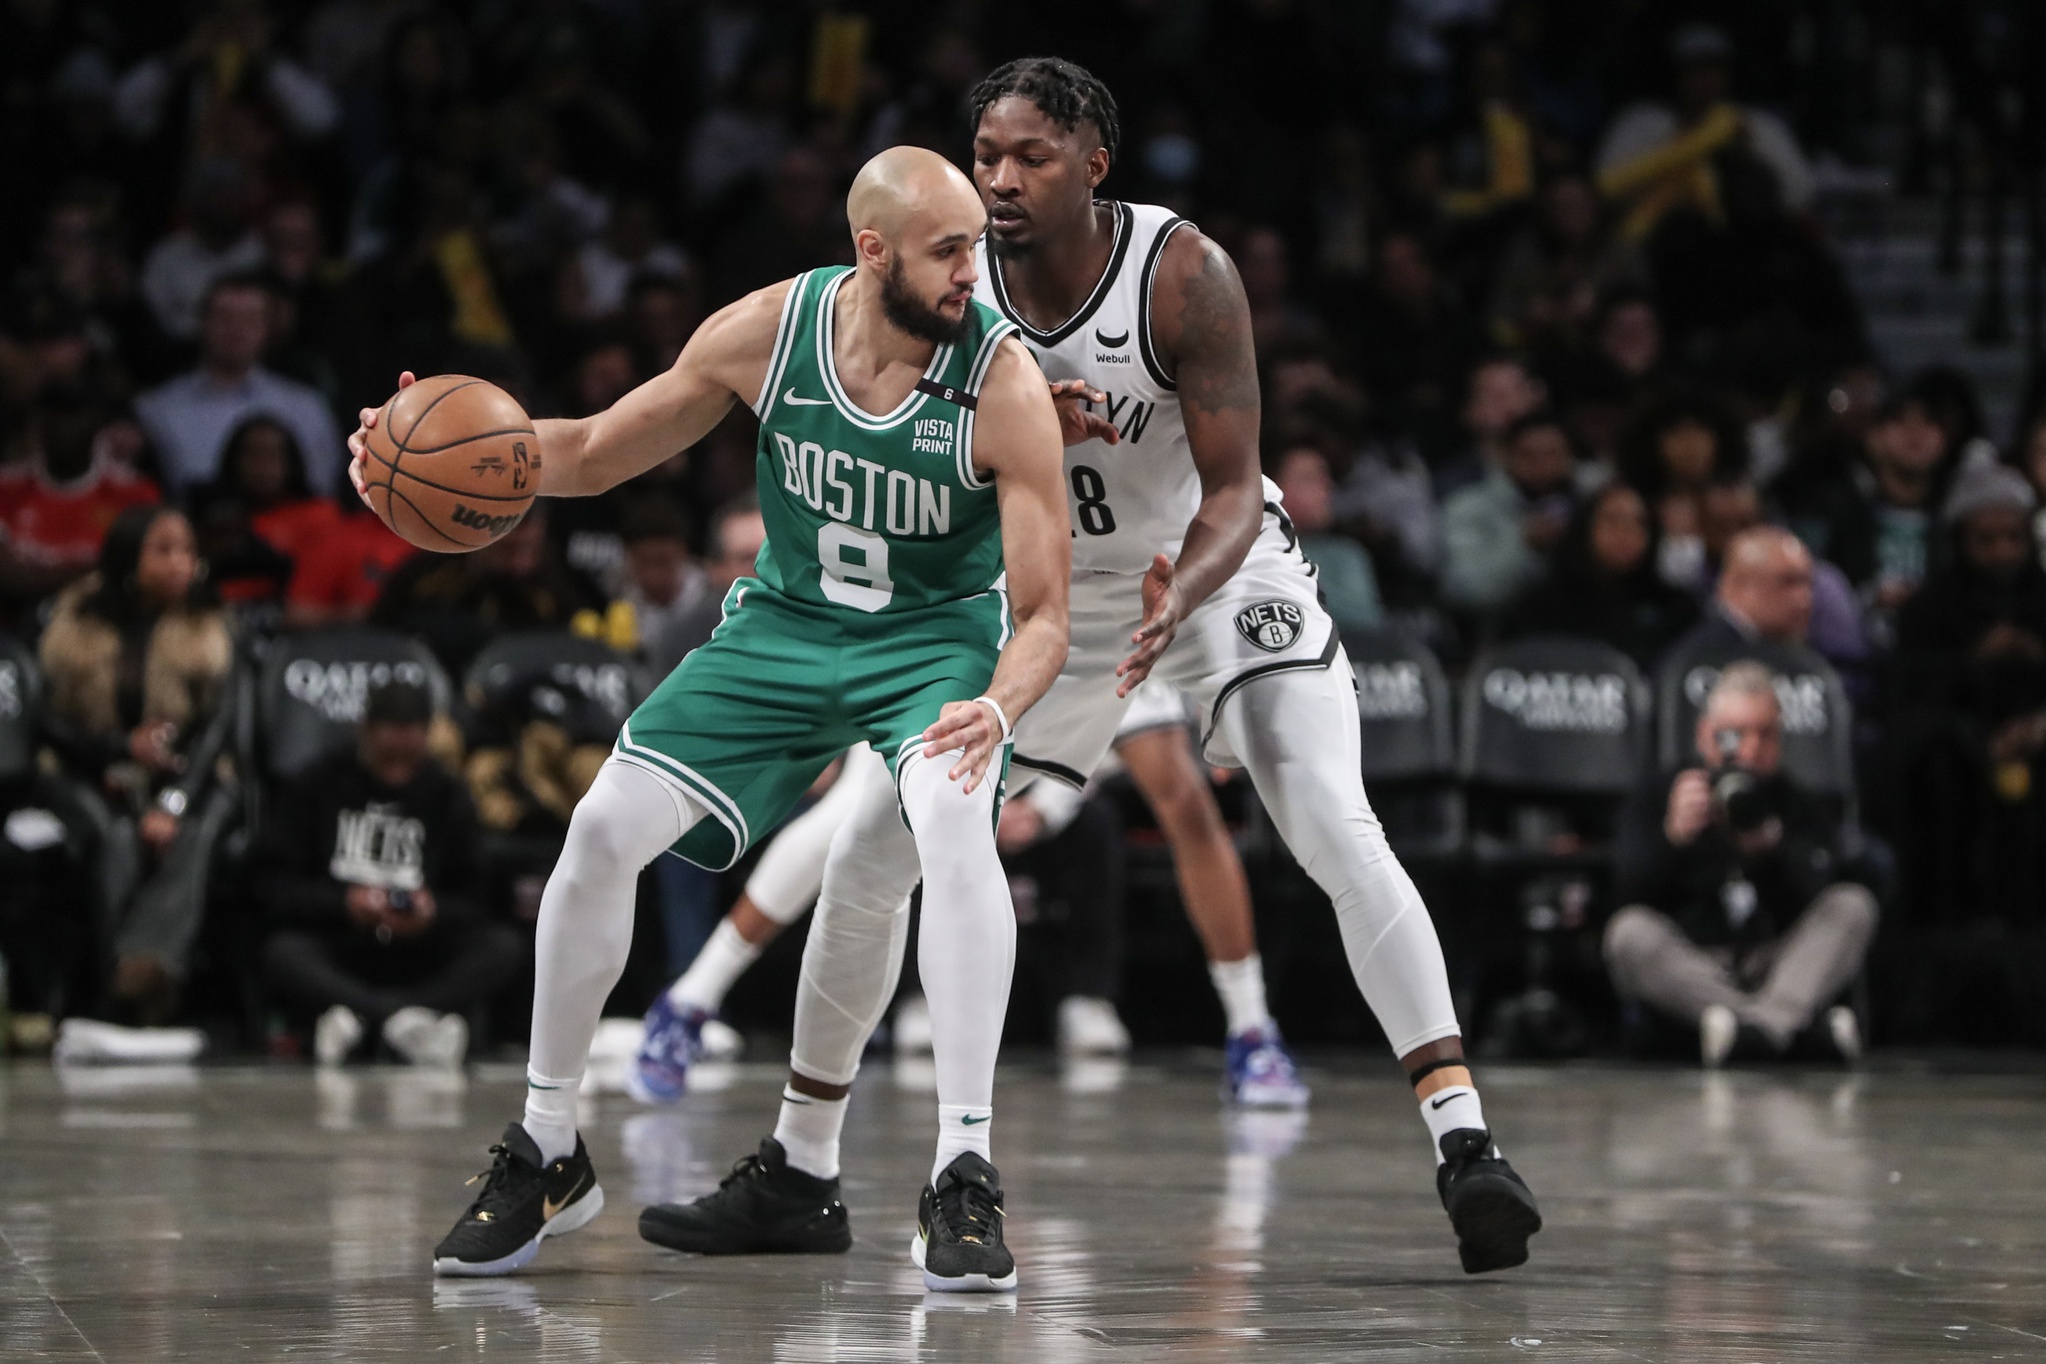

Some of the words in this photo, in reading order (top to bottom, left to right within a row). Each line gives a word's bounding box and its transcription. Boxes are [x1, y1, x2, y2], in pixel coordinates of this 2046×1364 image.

[1096, 353, 1131, 364] Webull
[943, 387, 955, 400] 6
[914, 418, 953, 441] VISTA
[912, 438, 953, 455] PRINT
[774, 431, 950, 536] BOSTON
[1071, 465, 1117, 539] 8
[1240, 602, 1301, 633] NETS
[1269, 625, 1283, 644] B
